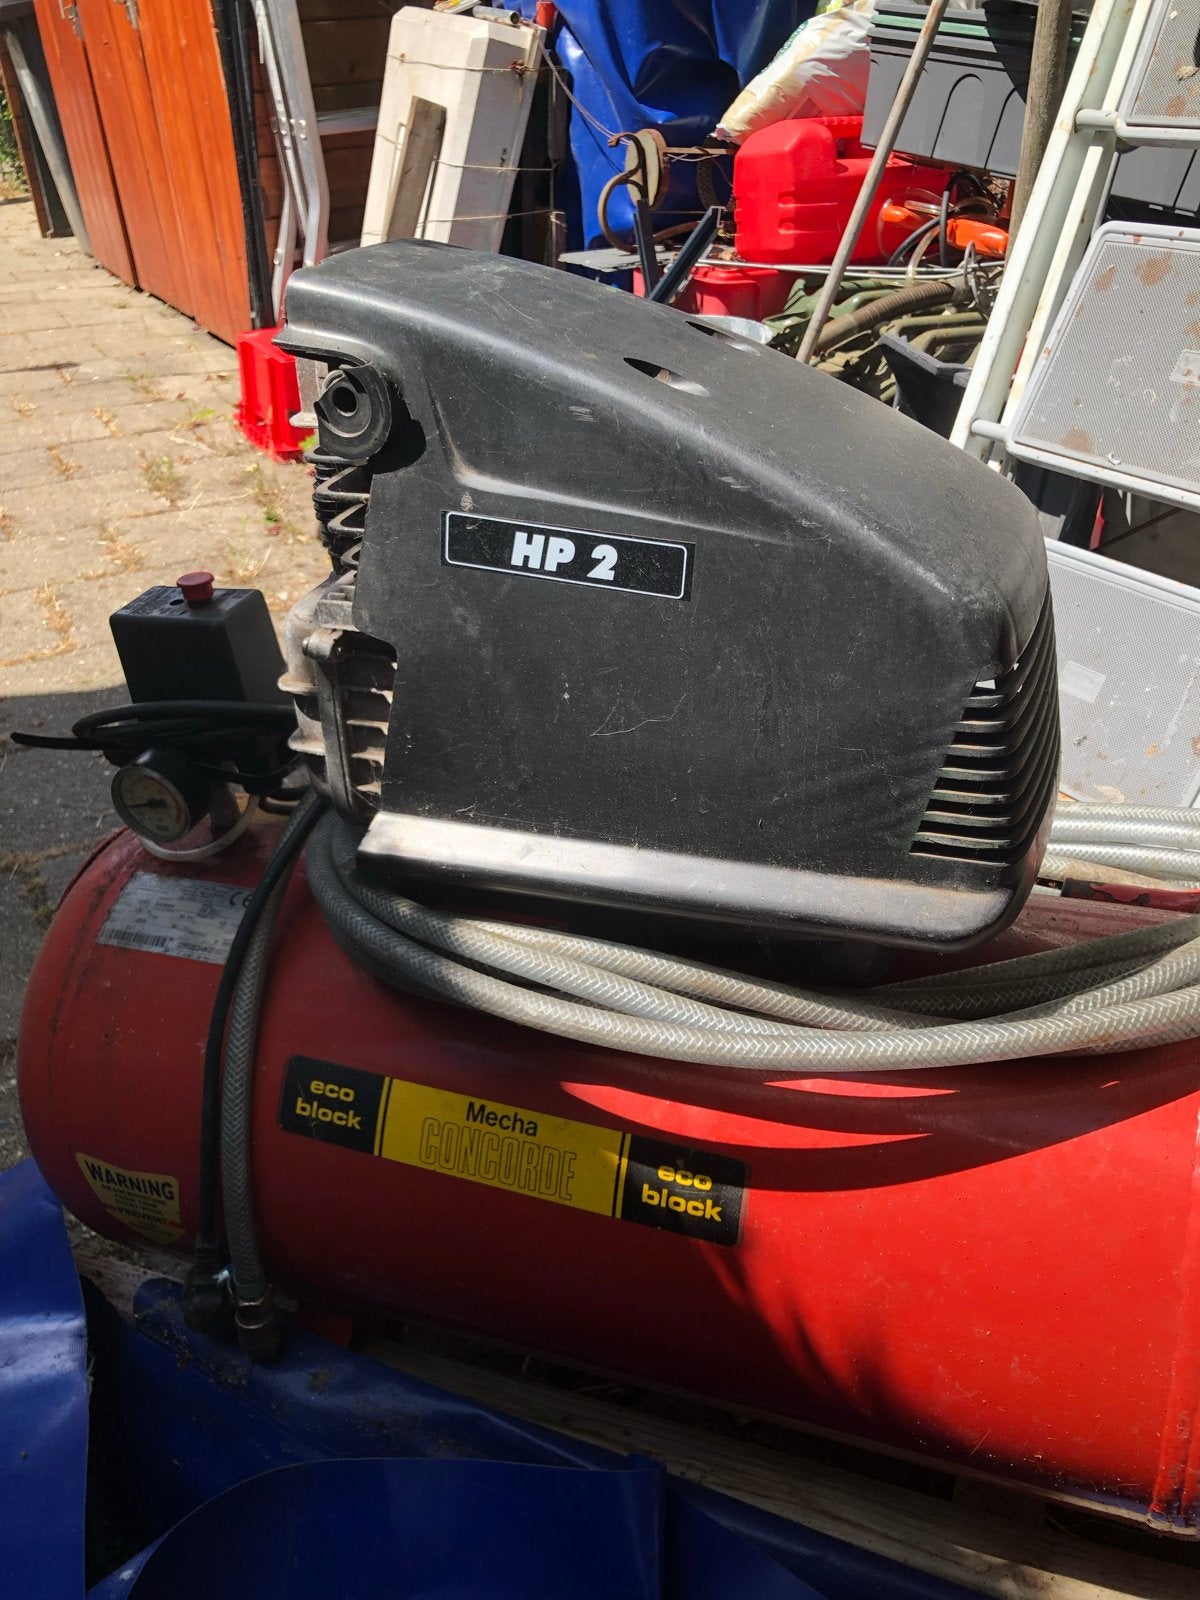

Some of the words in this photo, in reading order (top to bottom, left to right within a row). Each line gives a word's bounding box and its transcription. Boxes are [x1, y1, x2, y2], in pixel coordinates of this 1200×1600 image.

[511, 531, 576, 572] HP
[586, 544, 618, 581] 2
[310, 1080, 355, 1102] eco
[295, 1097, 362, 1130] block
[466, 1101, 538, 1137] Mecha
[419, 1116, 577, 1200] CONCORDE
[84, 1160, 174, 1200] WARNING
[657, 1165, 712, 1191] eco
[641, 1183, 722, 1222] block
